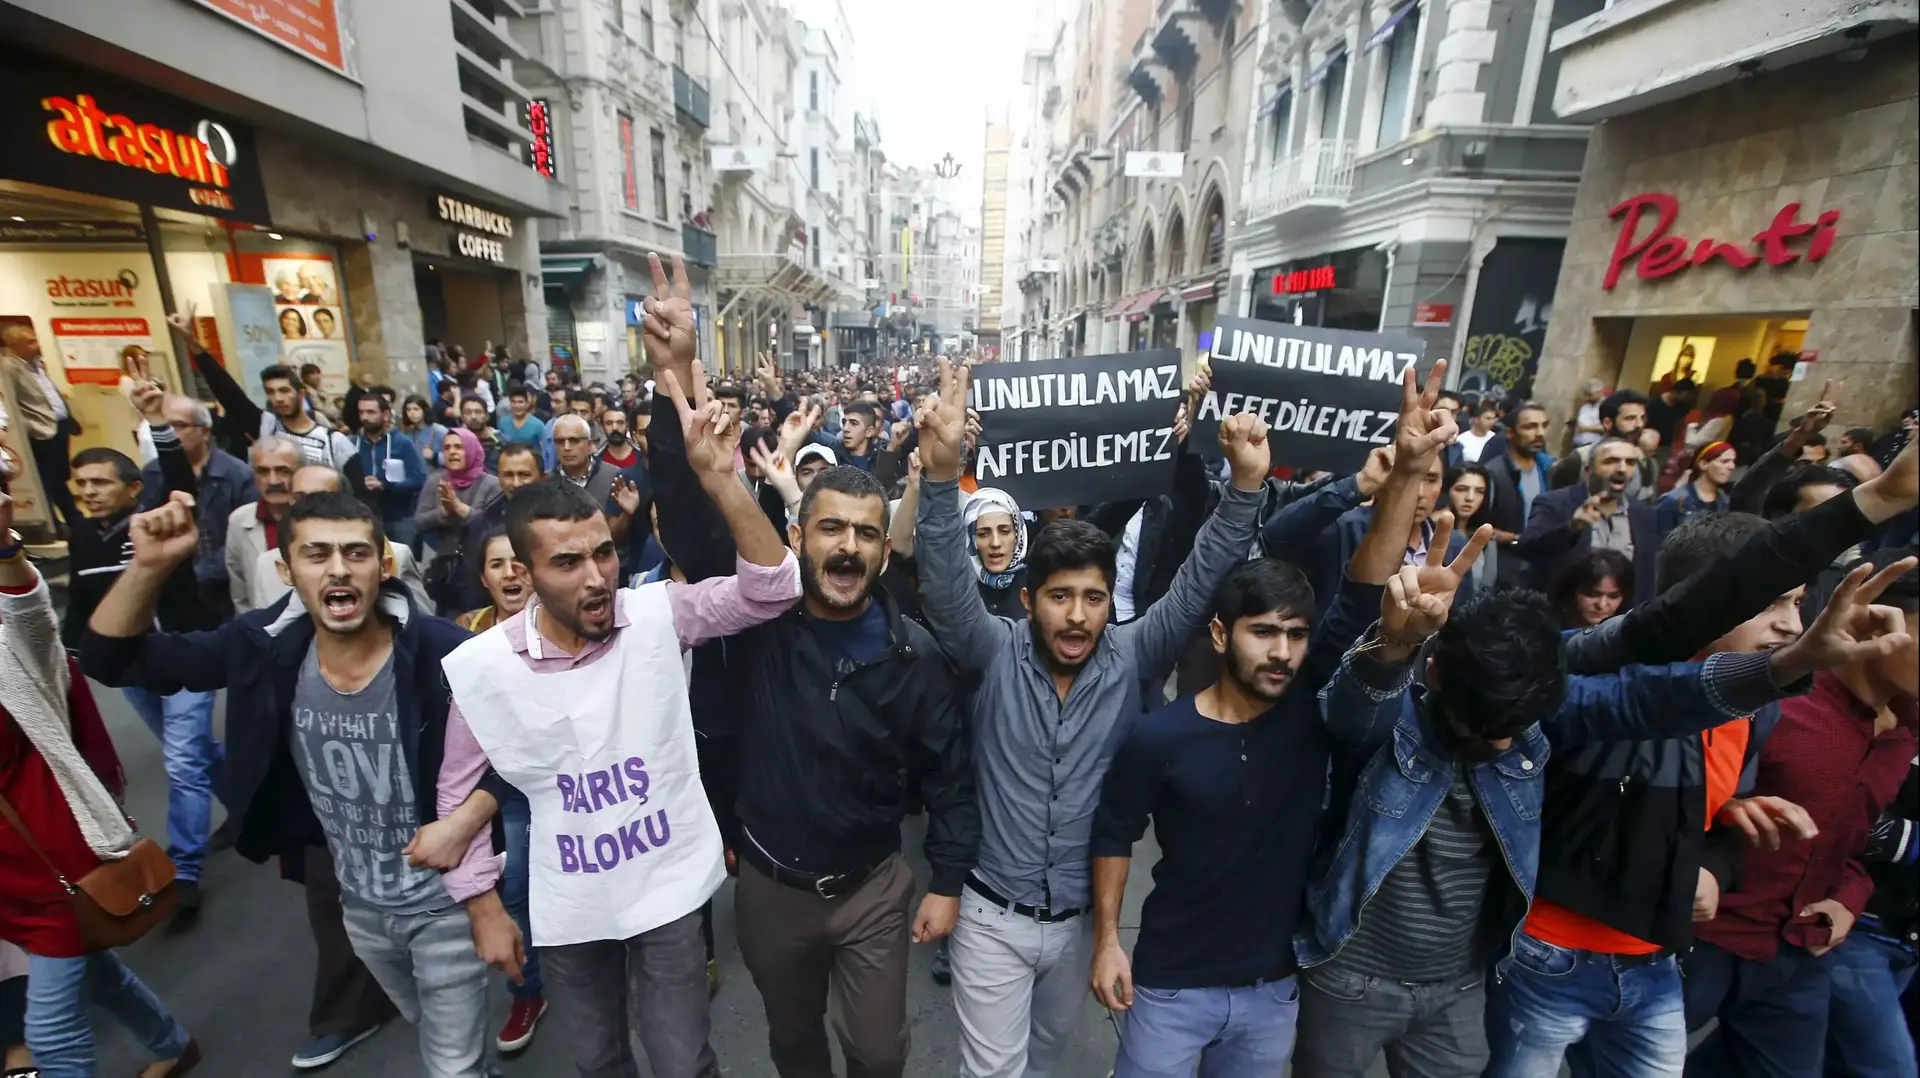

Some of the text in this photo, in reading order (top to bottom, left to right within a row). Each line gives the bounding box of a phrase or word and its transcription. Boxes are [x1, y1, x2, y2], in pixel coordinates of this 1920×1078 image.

[438, 194, 513, 238] STARBUCKS
[1602, 193, 1841, 291] Penti
[458, 232, 504, 262] COFFEE
[1211, 326, 1418, 386] UNUTULAMAZ
[974, 364, 1181, 412] UNUTULAMAZ
[976, 427, 1174, 481] AFFEDİLEMEZ
[556, 756, 650, 813] BARIŞ
[556, 808, 671, 873] BLOKU
